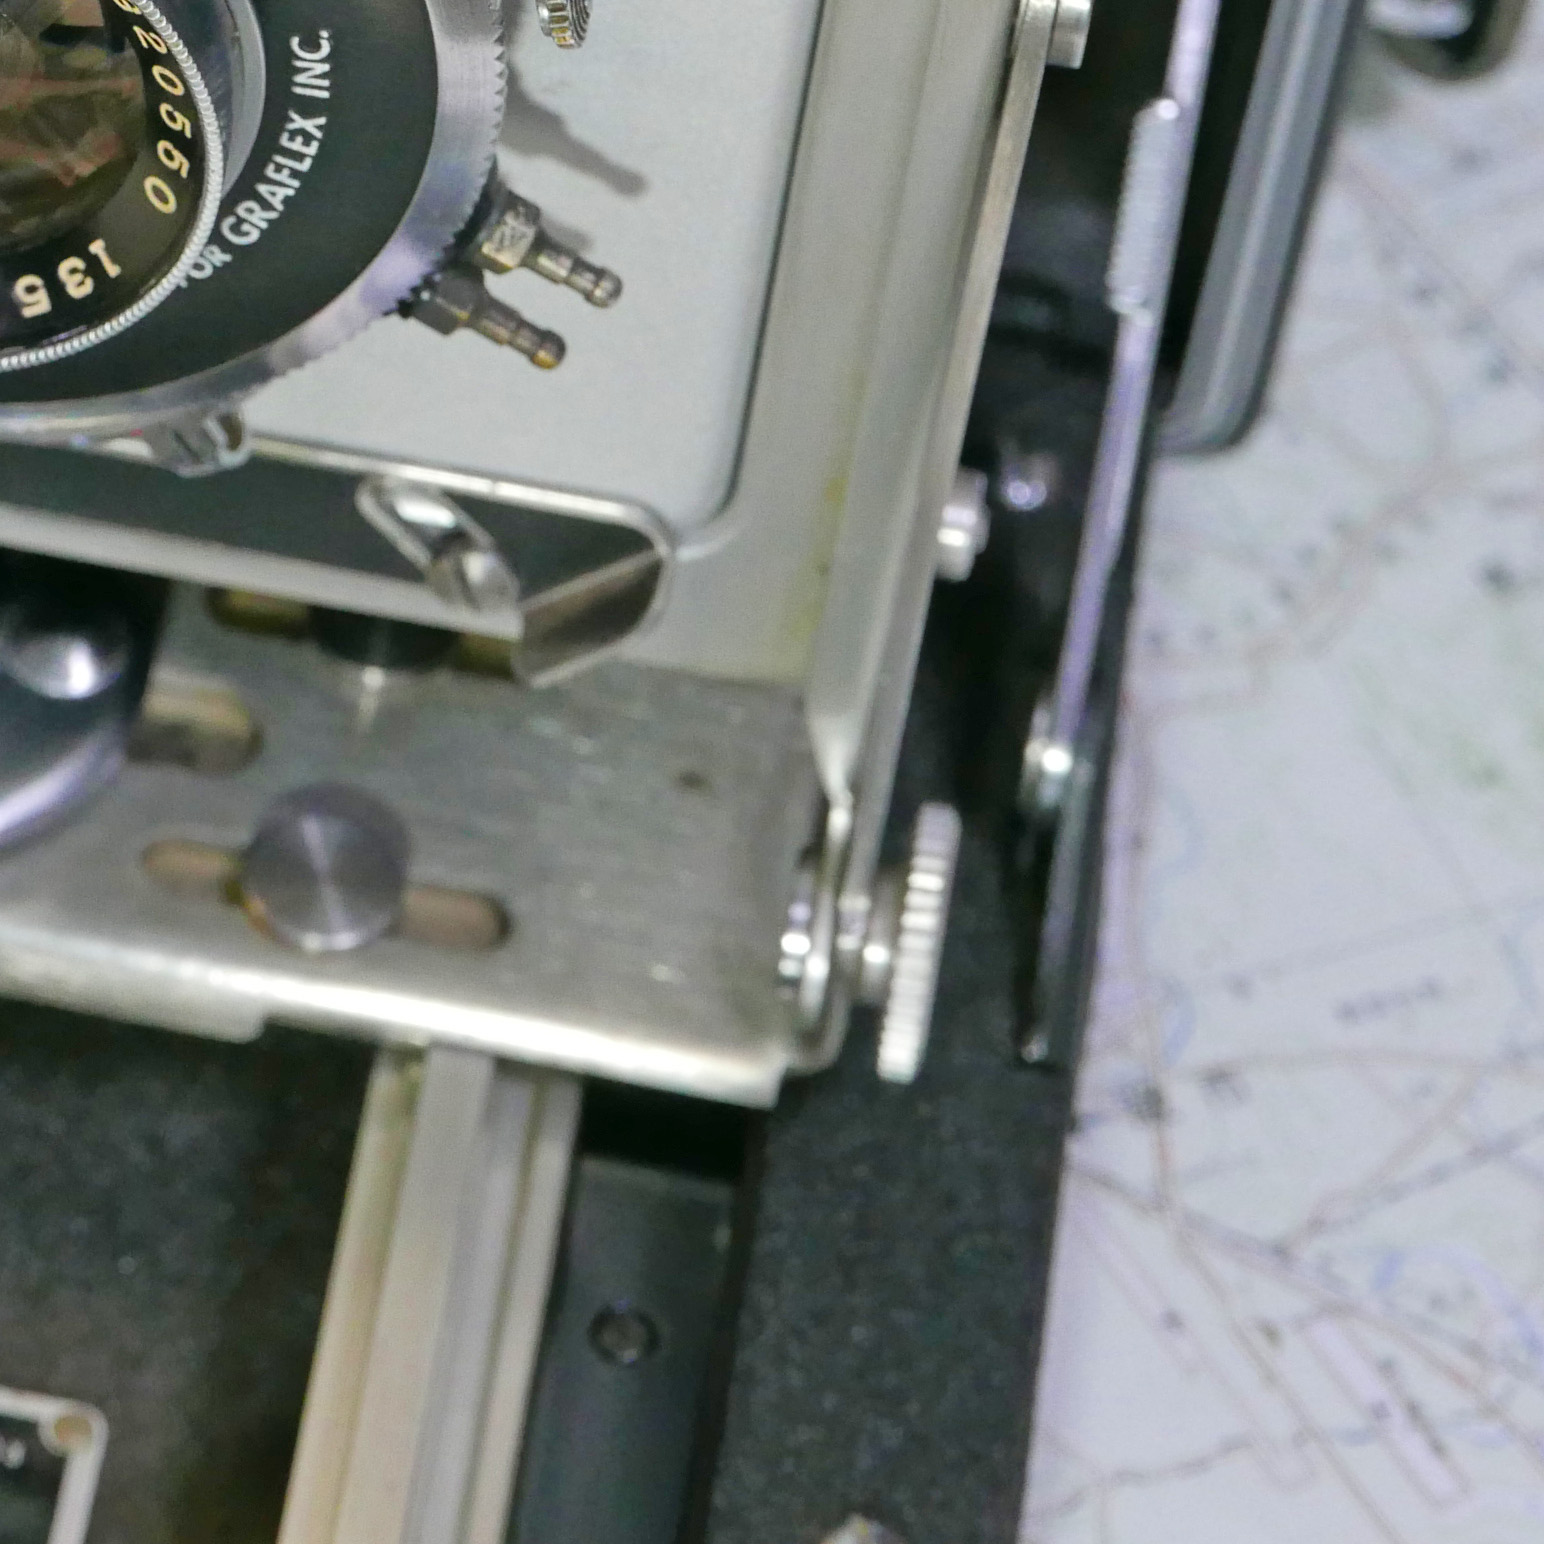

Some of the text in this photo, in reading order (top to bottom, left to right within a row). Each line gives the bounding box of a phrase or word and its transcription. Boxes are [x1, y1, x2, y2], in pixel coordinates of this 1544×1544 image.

[176, 27, 333, 289] OR GRAFLEX INC.
[11, 238, 123, 320] 135
